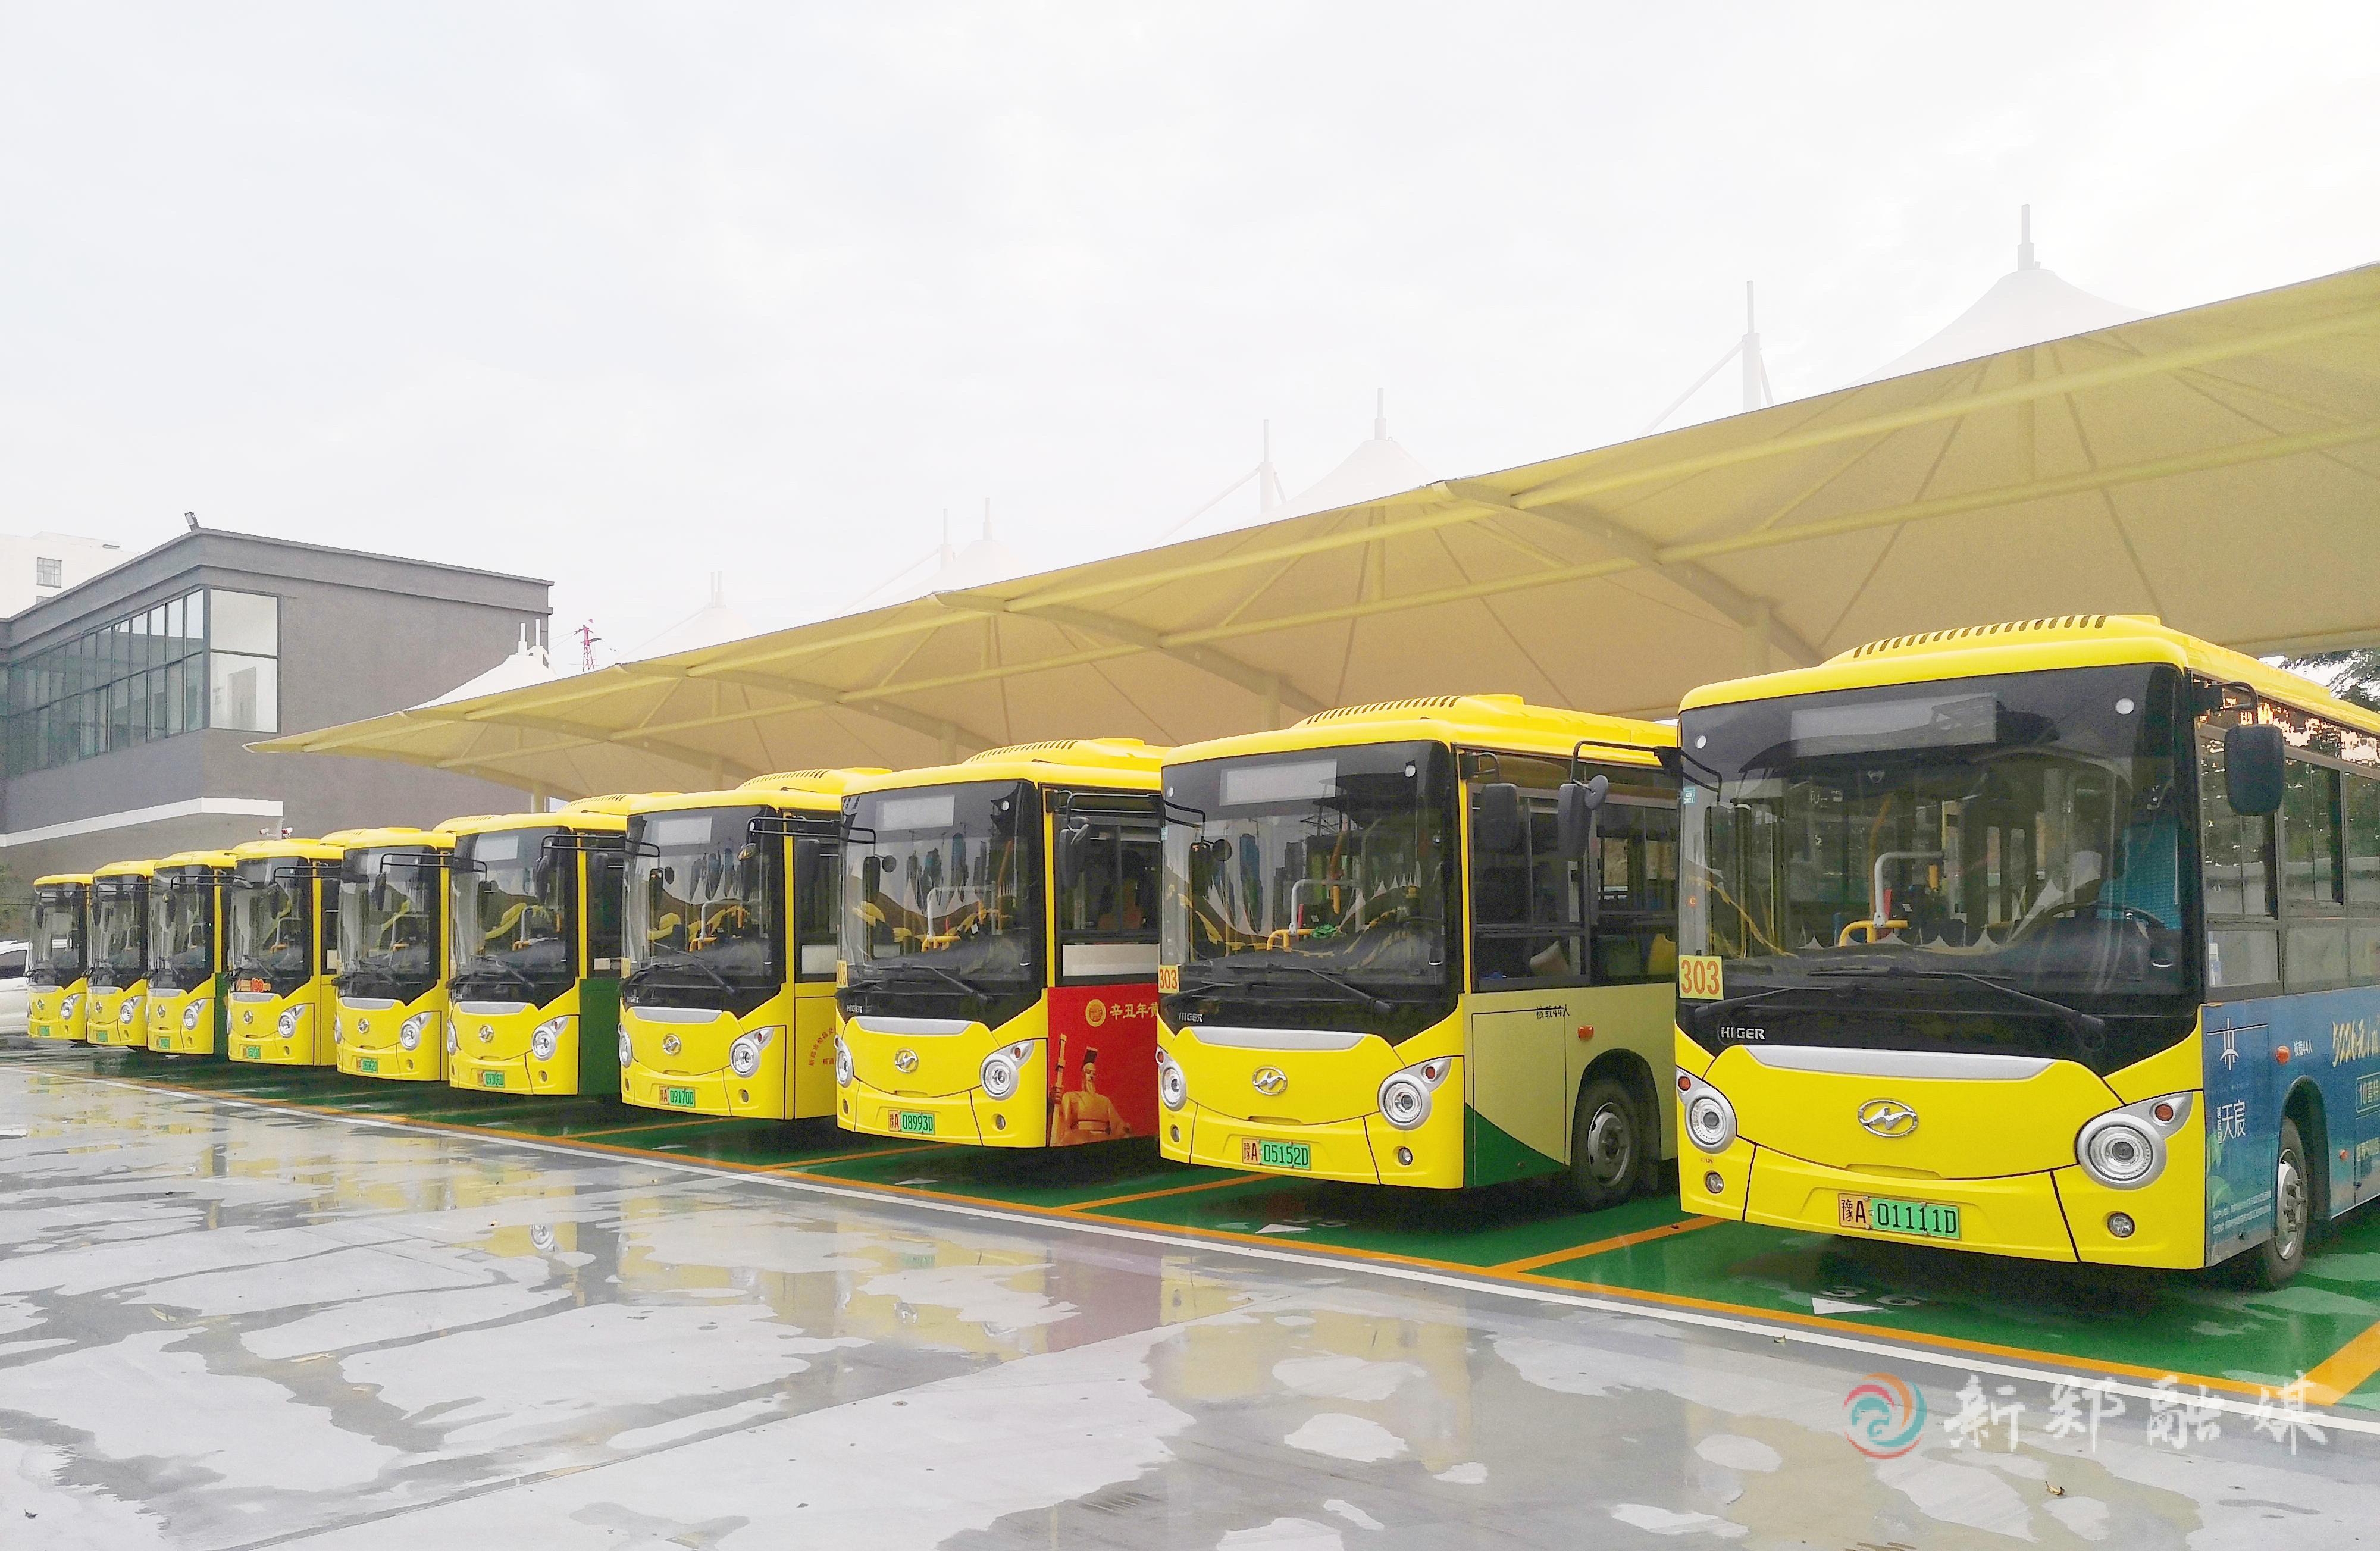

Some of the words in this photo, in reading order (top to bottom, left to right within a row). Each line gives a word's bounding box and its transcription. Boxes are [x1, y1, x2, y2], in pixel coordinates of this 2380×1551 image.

[1160, 969, 1178, 989] 303
[1681, 960, 1720, 995] 303
[1721, 1027, 1765, 1040] HIGER
